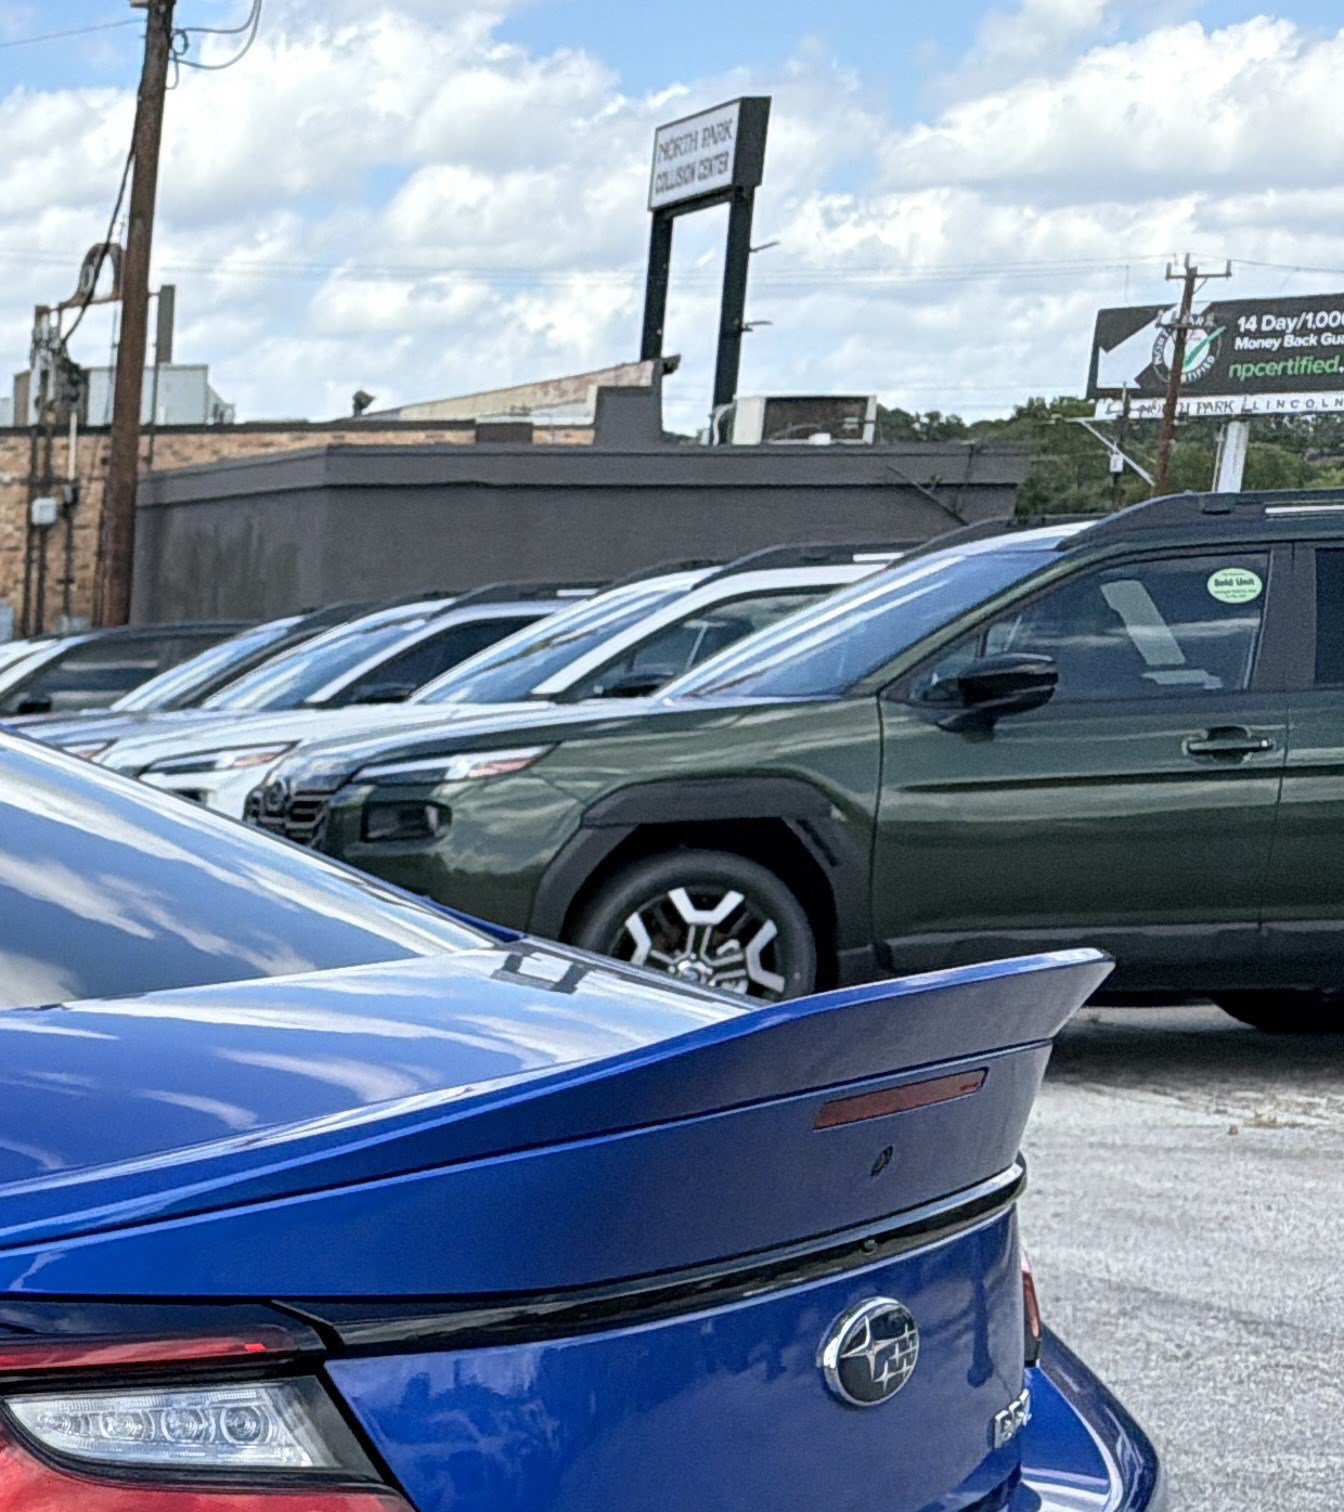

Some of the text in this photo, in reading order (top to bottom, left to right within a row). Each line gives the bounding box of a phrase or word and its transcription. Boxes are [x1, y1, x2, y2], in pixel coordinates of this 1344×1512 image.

[658, 119, 733, 164] NORTH PARK
[1237, 315, 1257, 333] 14
[1234, 336, 1281, 352] Money
[1283, 332, 1318, 348] Back
